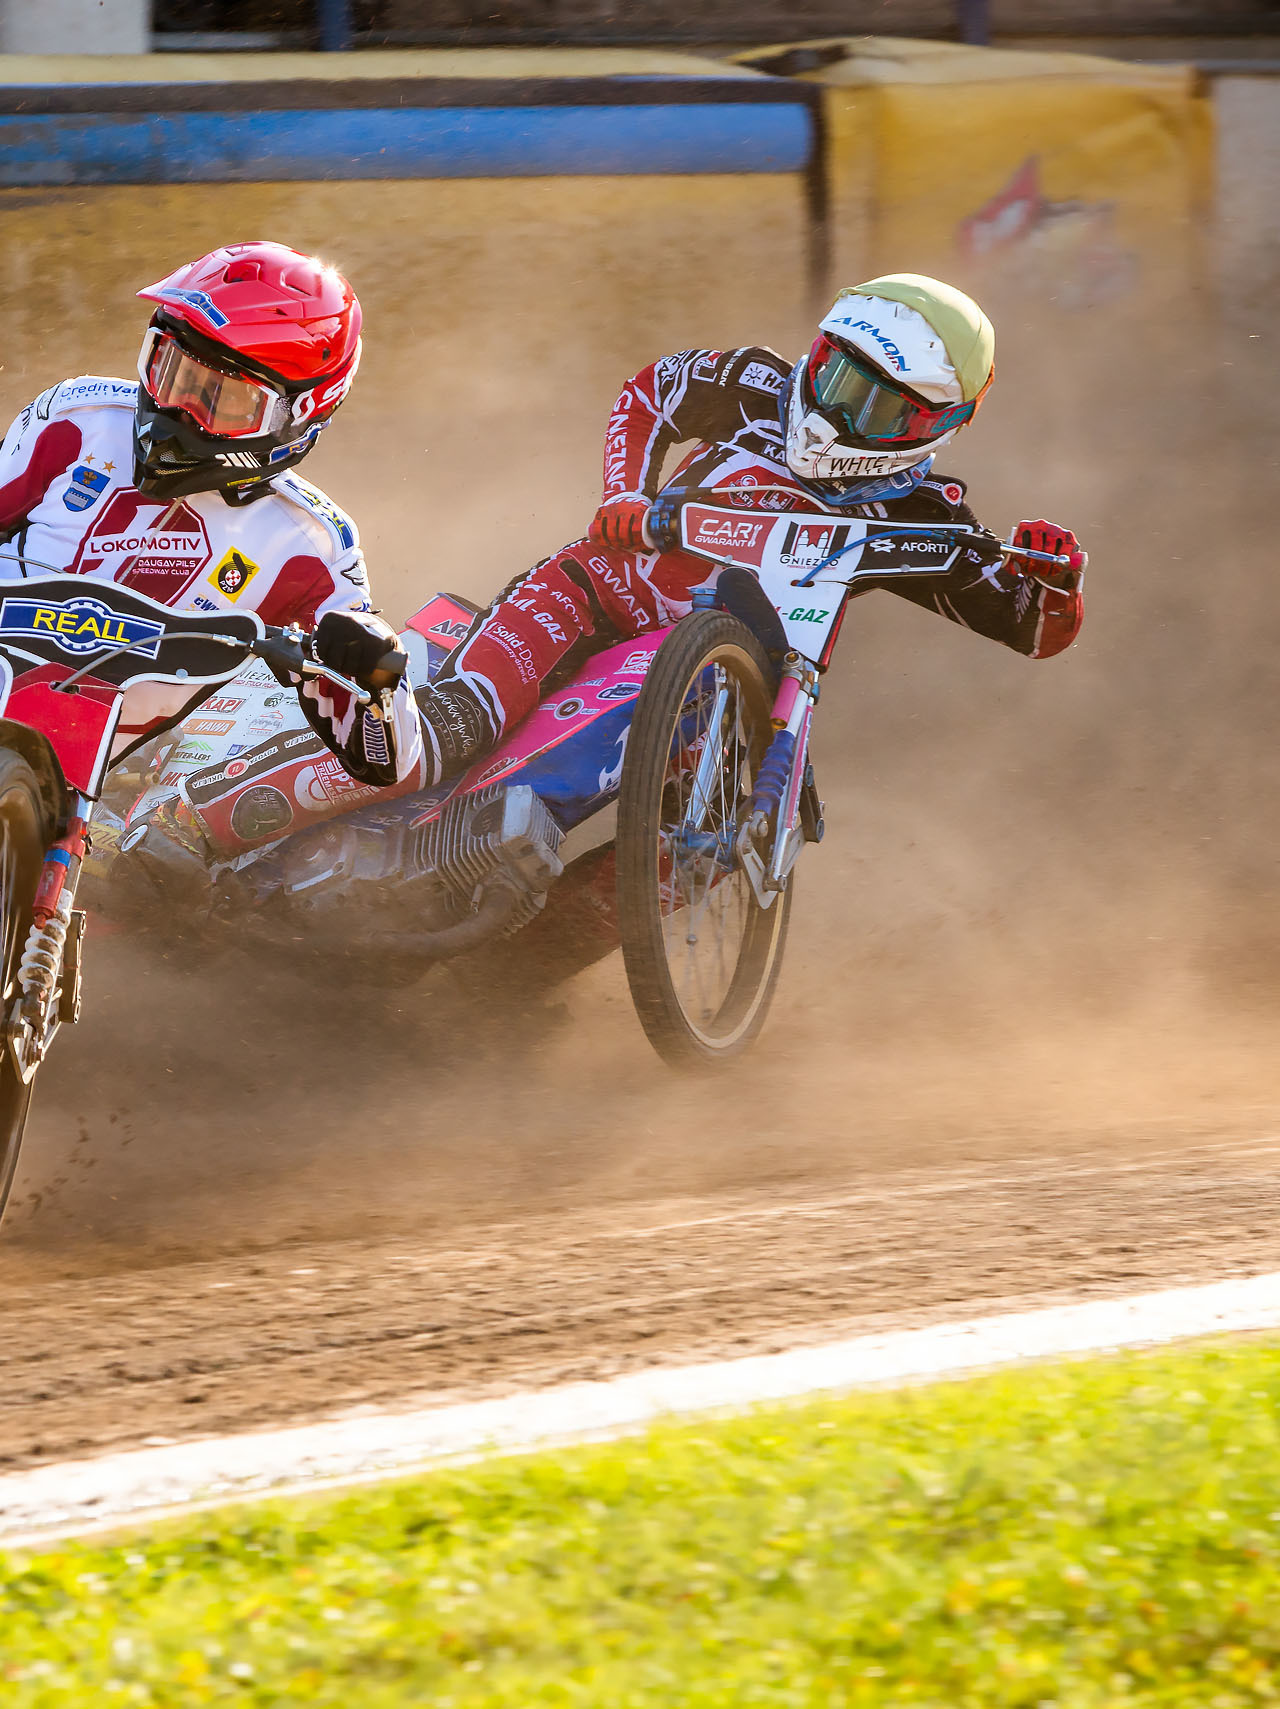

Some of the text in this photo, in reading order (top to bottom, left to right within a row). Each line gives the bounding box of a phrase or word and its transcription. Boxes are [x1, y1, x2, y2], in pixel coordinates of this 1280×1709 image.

[830, 316, 911, 372] ARMON
[90, 536, 201, 554] LOKOMOTIV
[694, 535, 748, 548] GWARANT
[900, 541, 949, 554] AFORTI
[138, 559, 197, 569] DAUGAVPILS
[132, 568, 191, 577] SPEEDWAY CLUB
[32, 608, 131, 643] REALL
